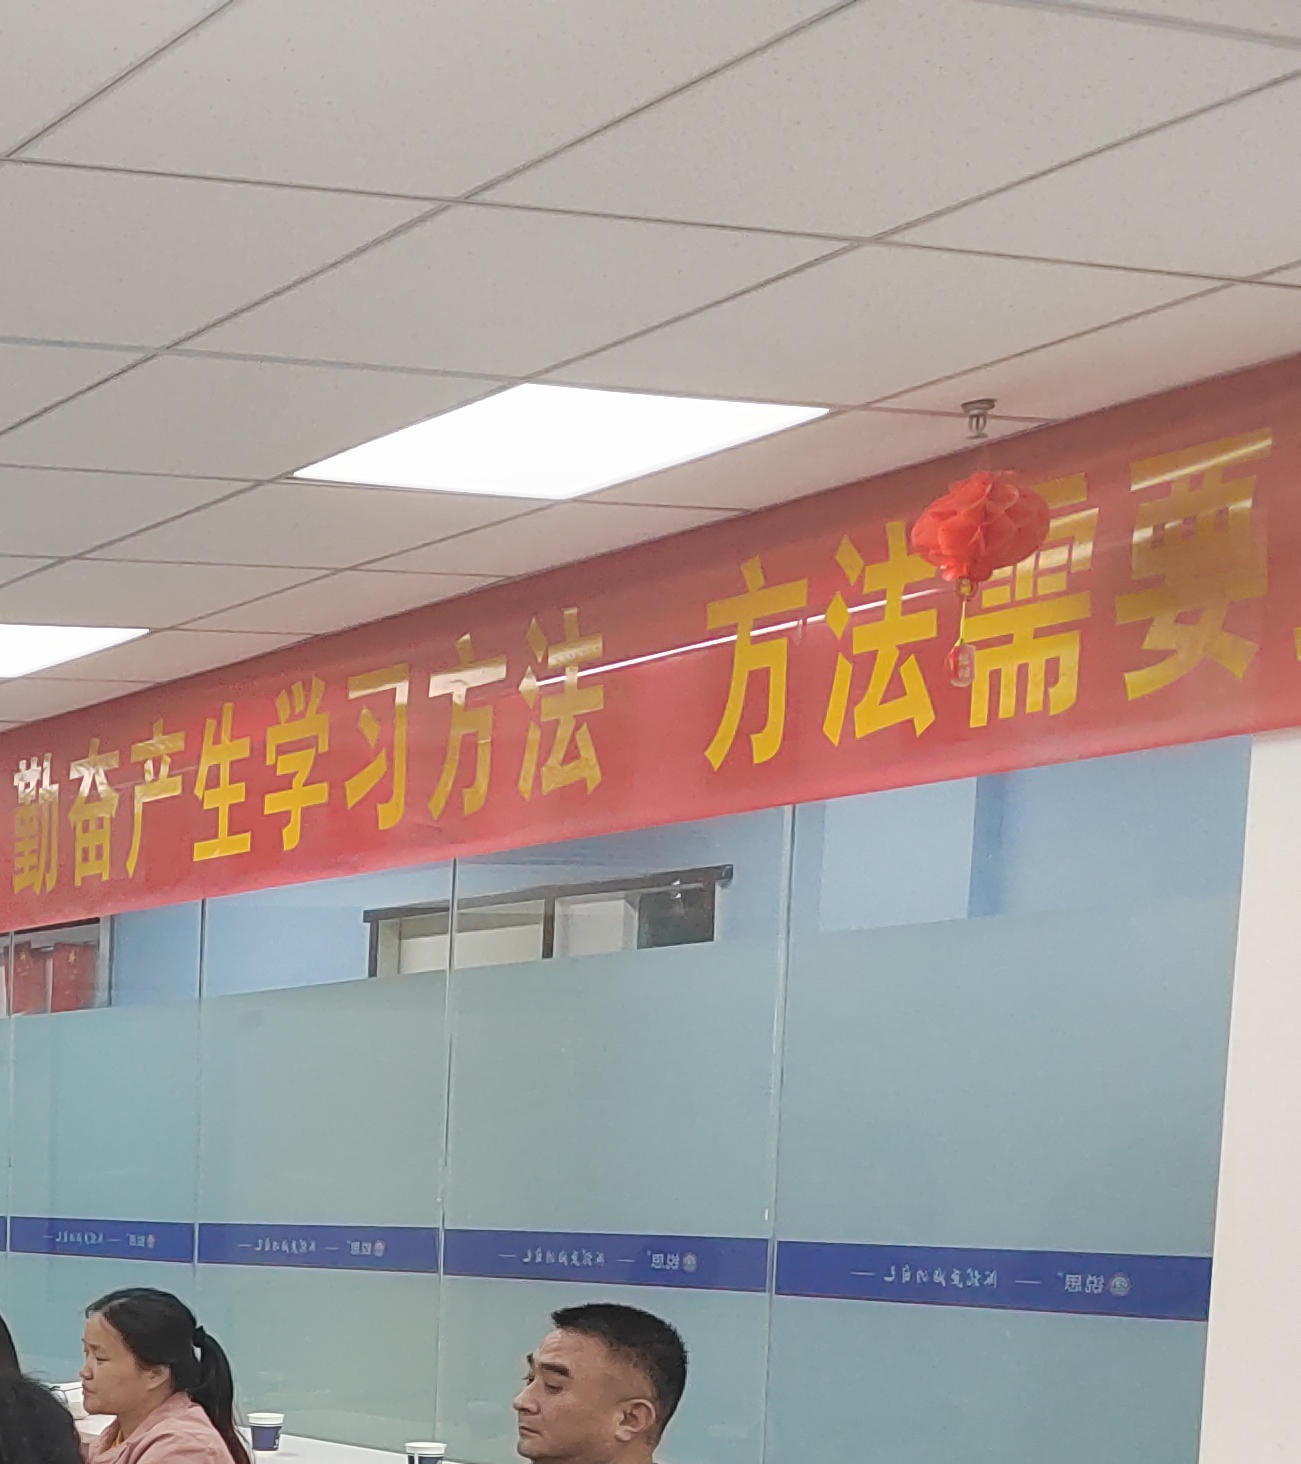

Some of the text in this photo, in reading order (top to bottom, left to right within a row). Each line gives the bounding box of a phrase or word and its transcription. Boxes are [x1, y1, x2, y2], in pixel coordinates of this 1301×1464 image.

[12, 426, 1301, 896] 勤奋产生学习方法 方法需要
